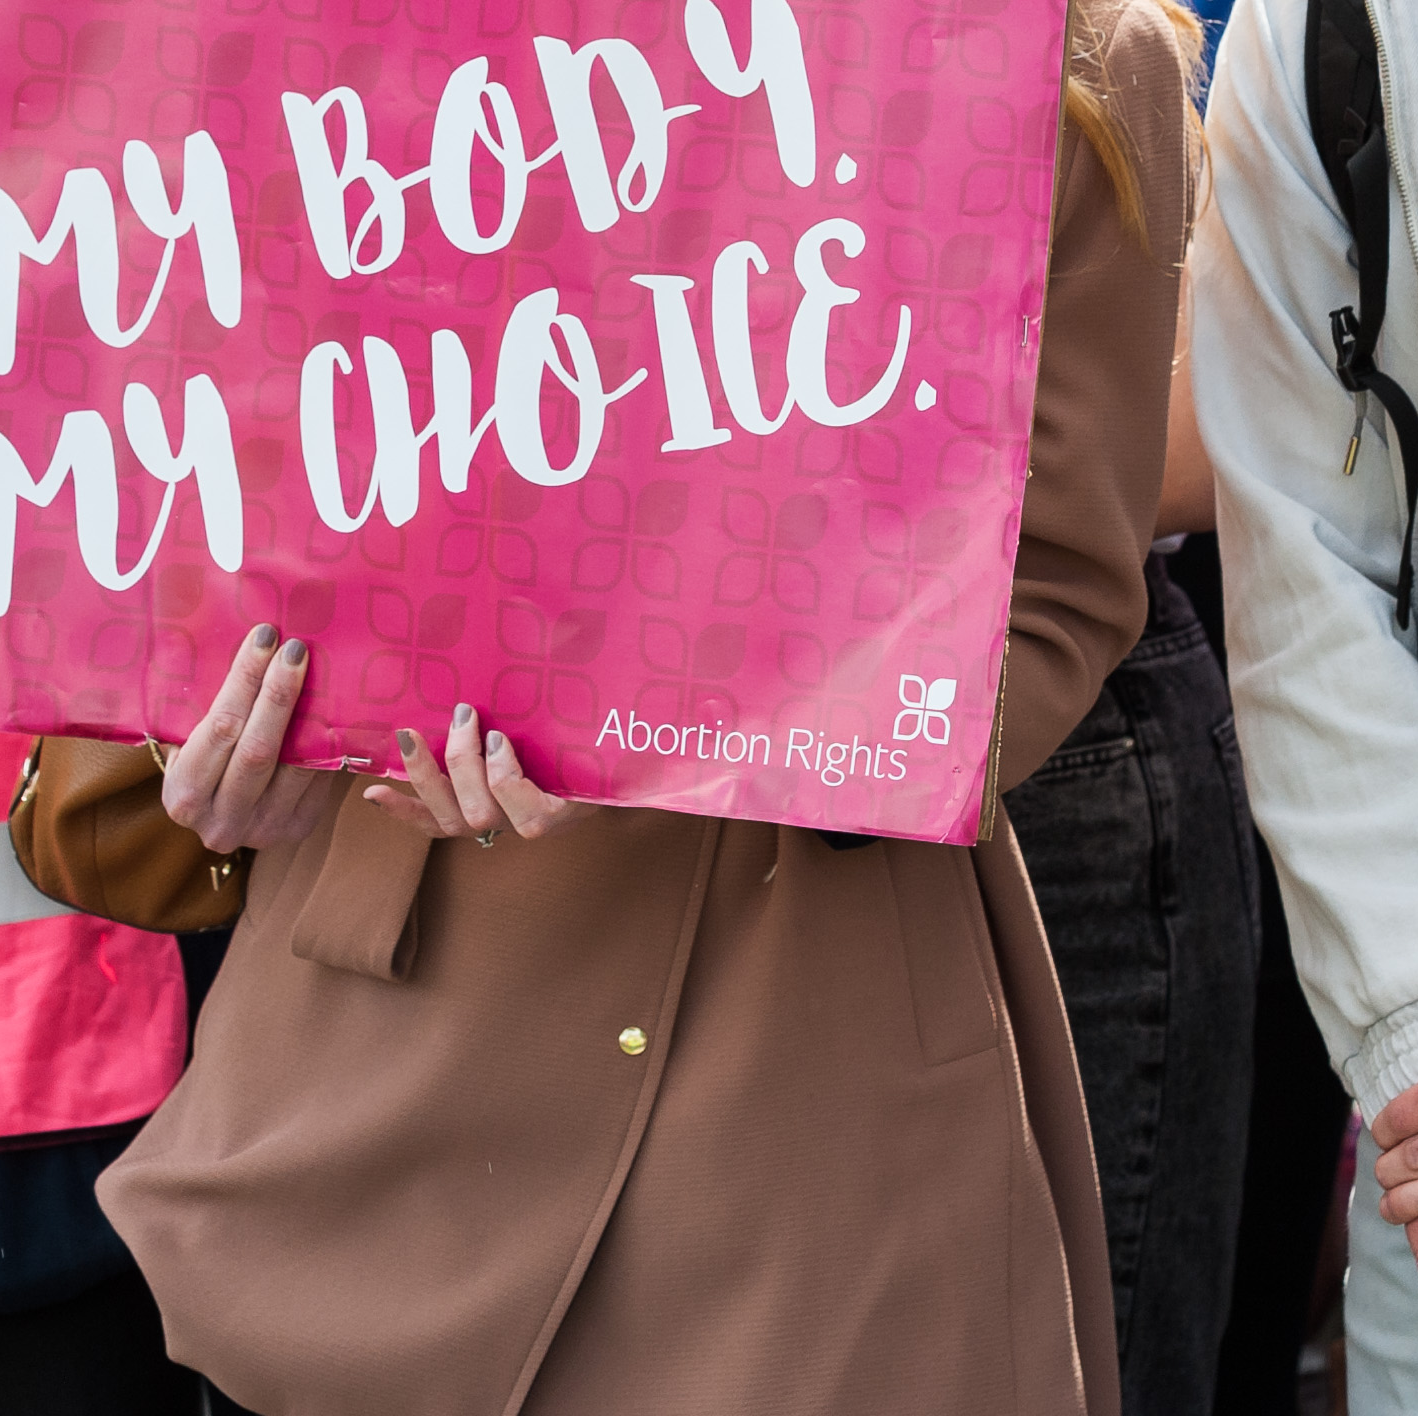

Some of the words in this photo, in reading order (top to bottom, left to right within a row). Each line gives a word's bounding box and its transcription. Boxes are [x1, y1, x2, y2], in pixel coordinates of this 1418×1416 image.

[298, 217, 939, 535] CHOICE.
[594, 706, 772, 768] Abortion
[782, 726, 909, 787] Rights
